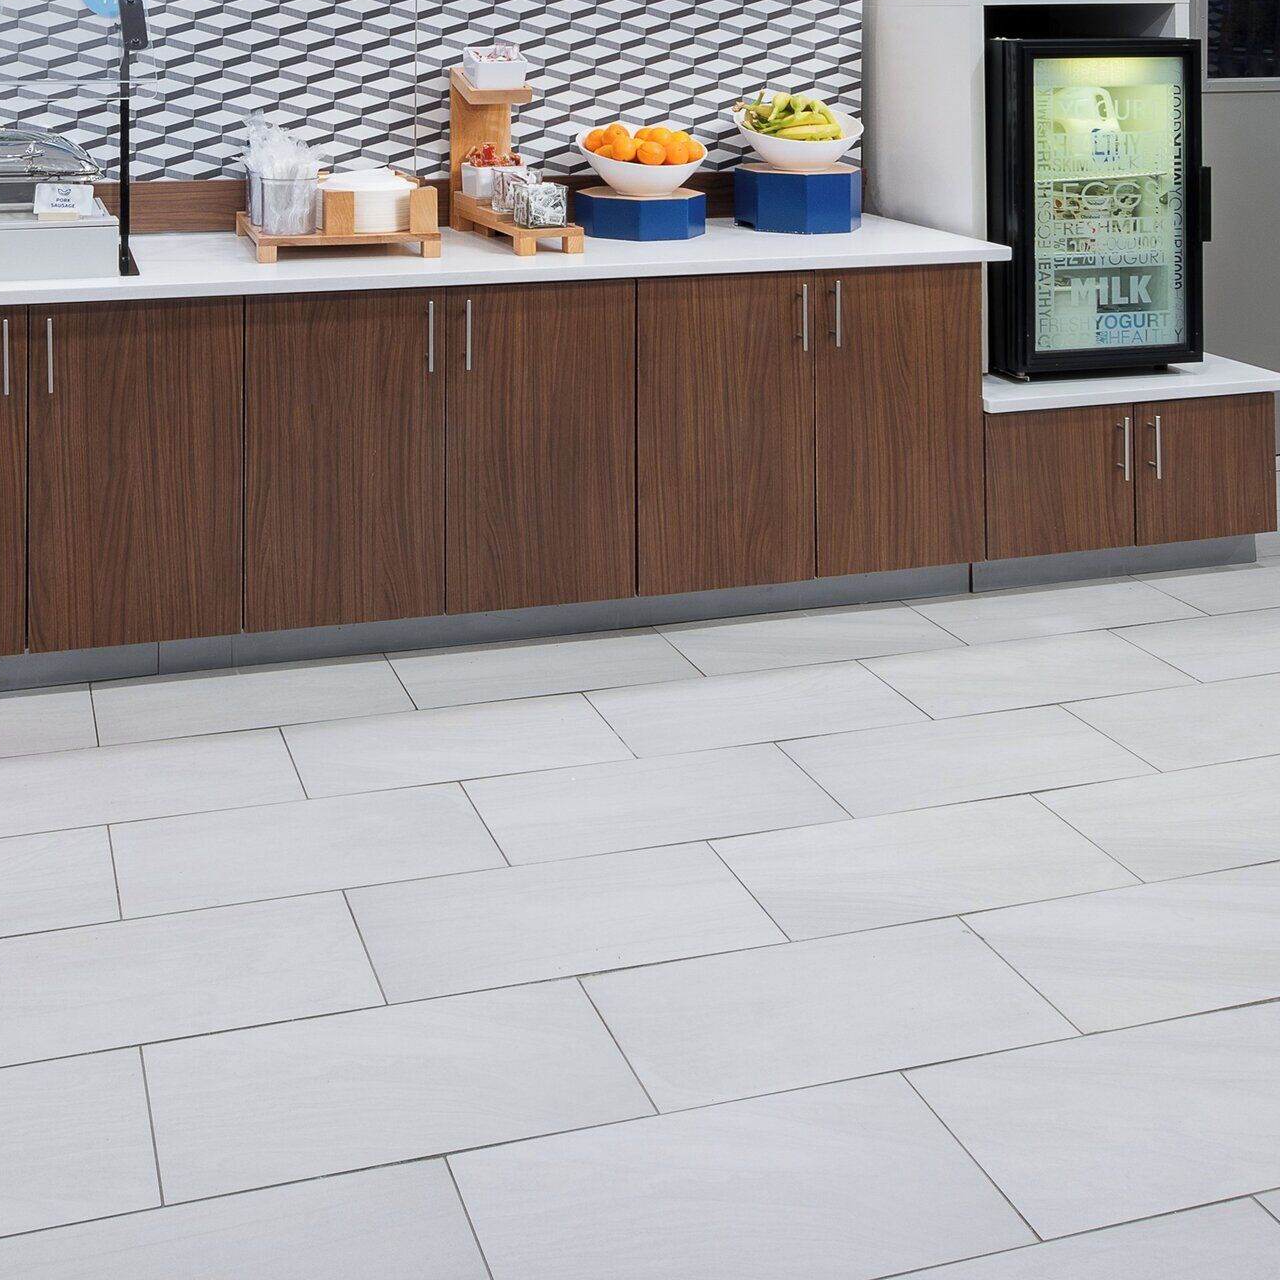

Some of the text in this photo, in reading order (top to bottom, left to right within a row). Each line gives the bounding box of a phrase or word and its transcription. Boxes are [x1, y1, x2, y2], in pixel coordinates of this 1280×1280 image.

[1063, 180, 1159, 210] EGGS
[1071, 274, 1152, 306] MILK
[1094, 313, 1169, 330] YOGURT
